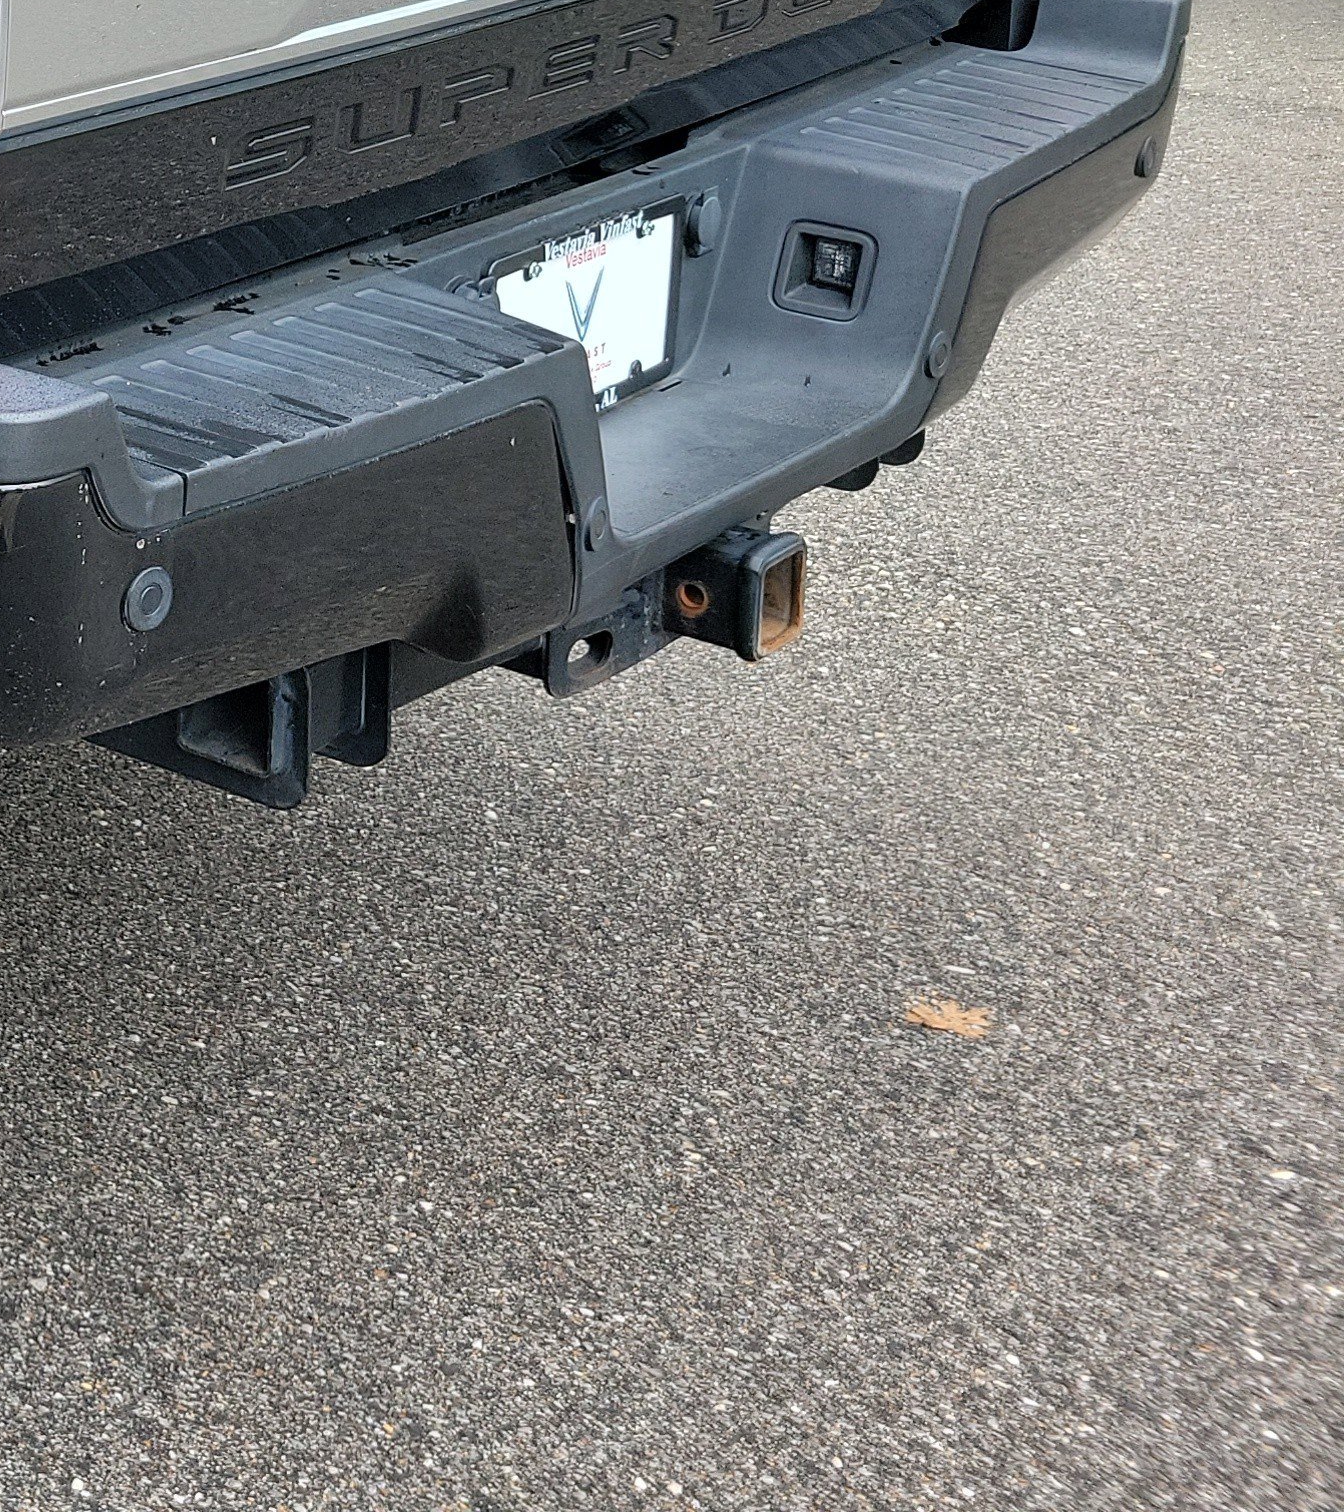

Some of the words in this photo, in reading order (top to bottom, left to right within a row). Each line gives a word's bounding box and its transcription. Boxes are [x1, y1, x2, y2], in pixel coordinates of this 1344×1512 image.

[223, 12, 681, 191] SUPER
[544, 227, 597, 262] Vestavia
[566, 243, 607, 268] Vestavia
[601, 387, 618, 409] AL
